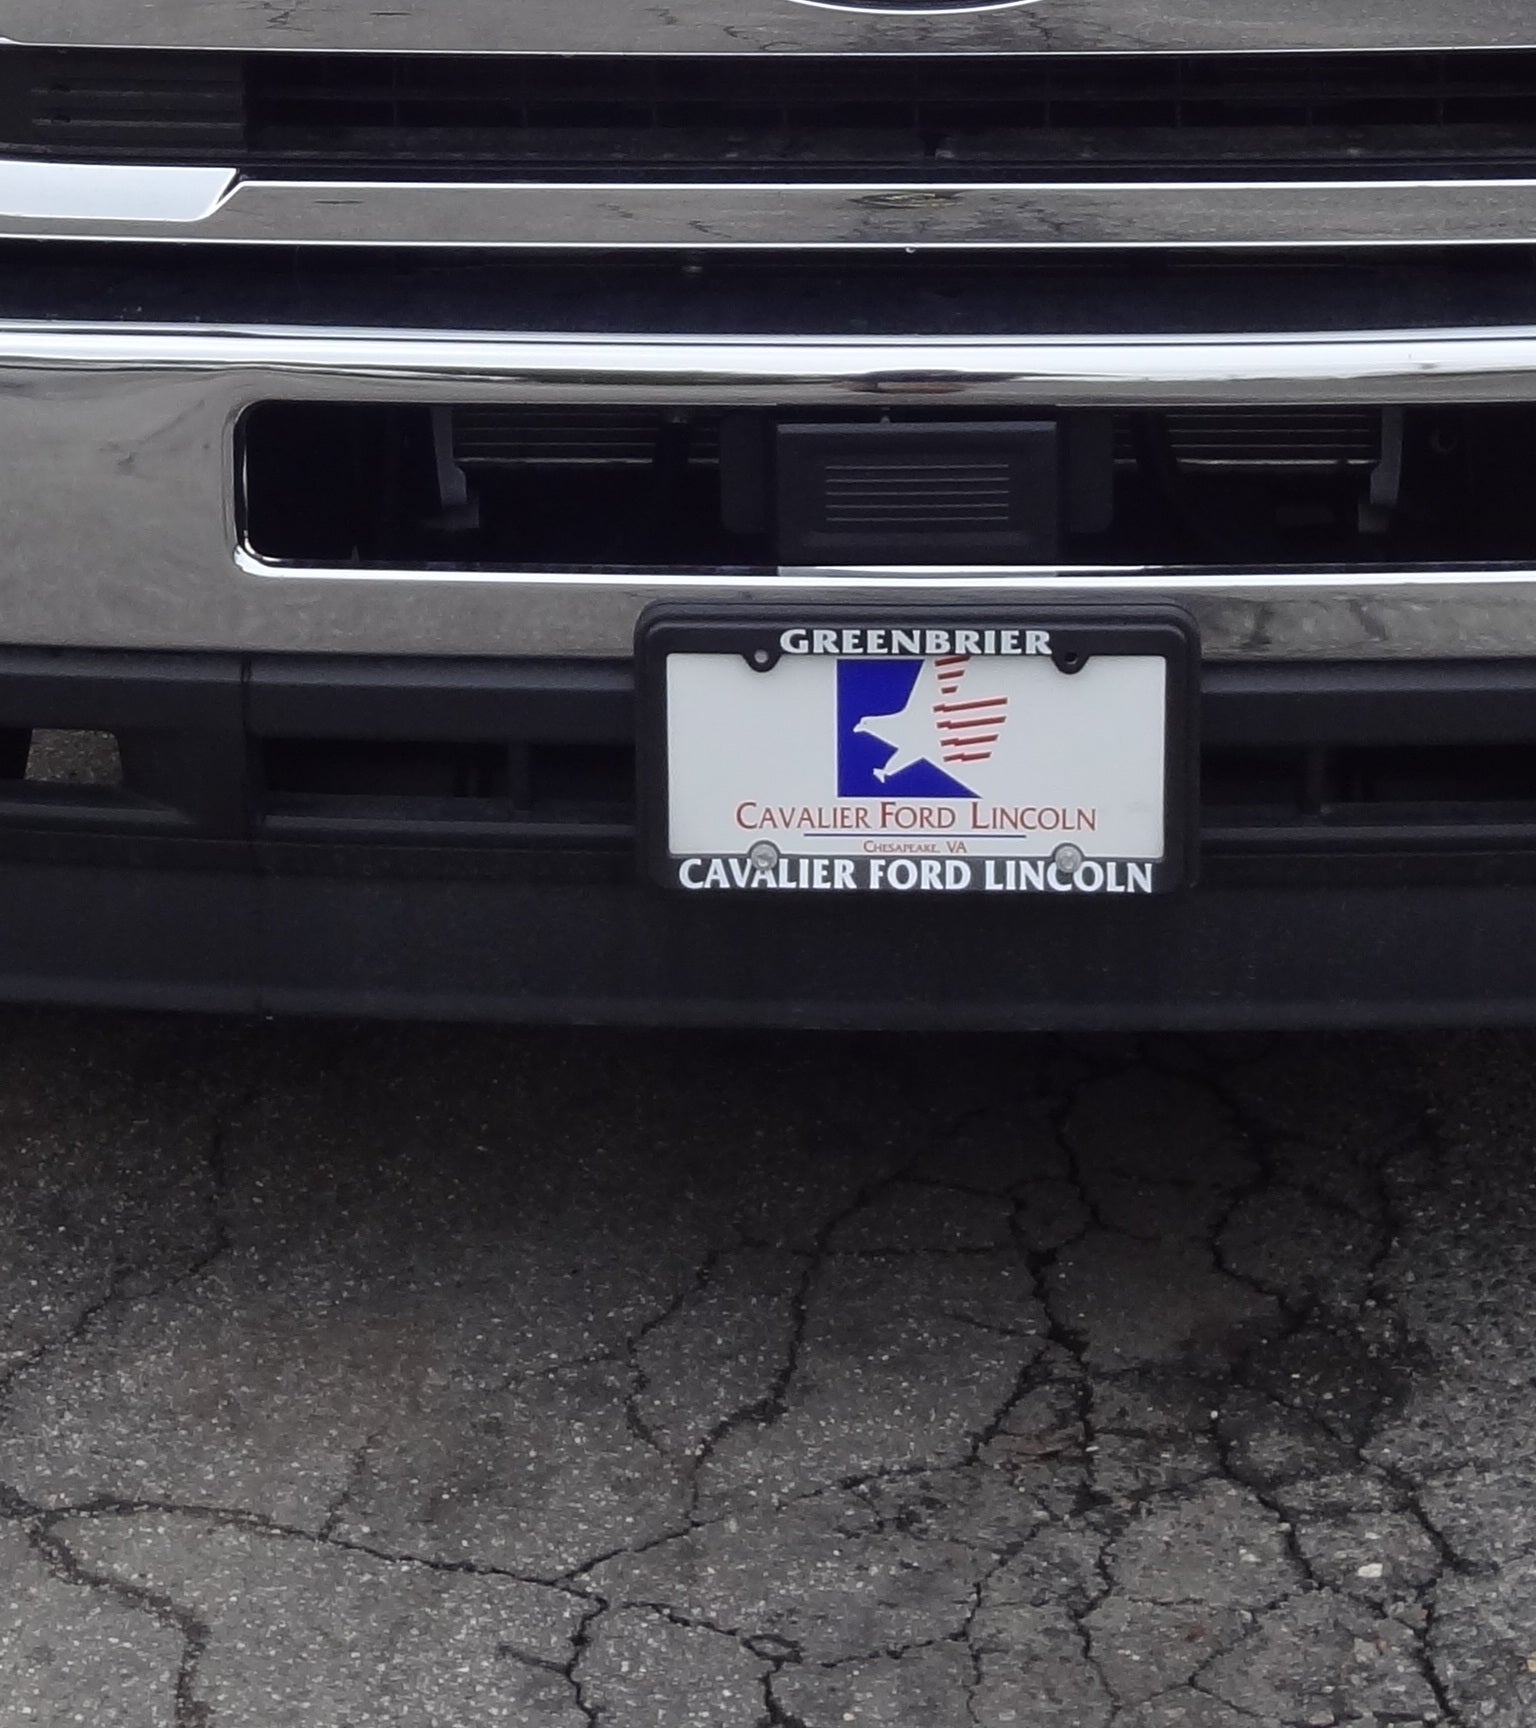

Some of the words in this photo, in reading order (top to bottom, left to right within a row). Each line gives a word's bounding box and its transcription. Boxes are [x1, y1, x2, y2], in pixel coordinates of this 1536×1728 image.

[779, 628, 1053, 656] GREENBRIER
[735, 801, 872, 830] CAVALIER
[879, 801, 957, 830] FORD
[970, 801, 1098, 832] LINCOLN
[946, 840, 968, 854] VA
[678, 857, 858, 890] CAVALIER
[869, 857, 972, 891] FORD
[984, 859, 1154, 894] LINCOLN
